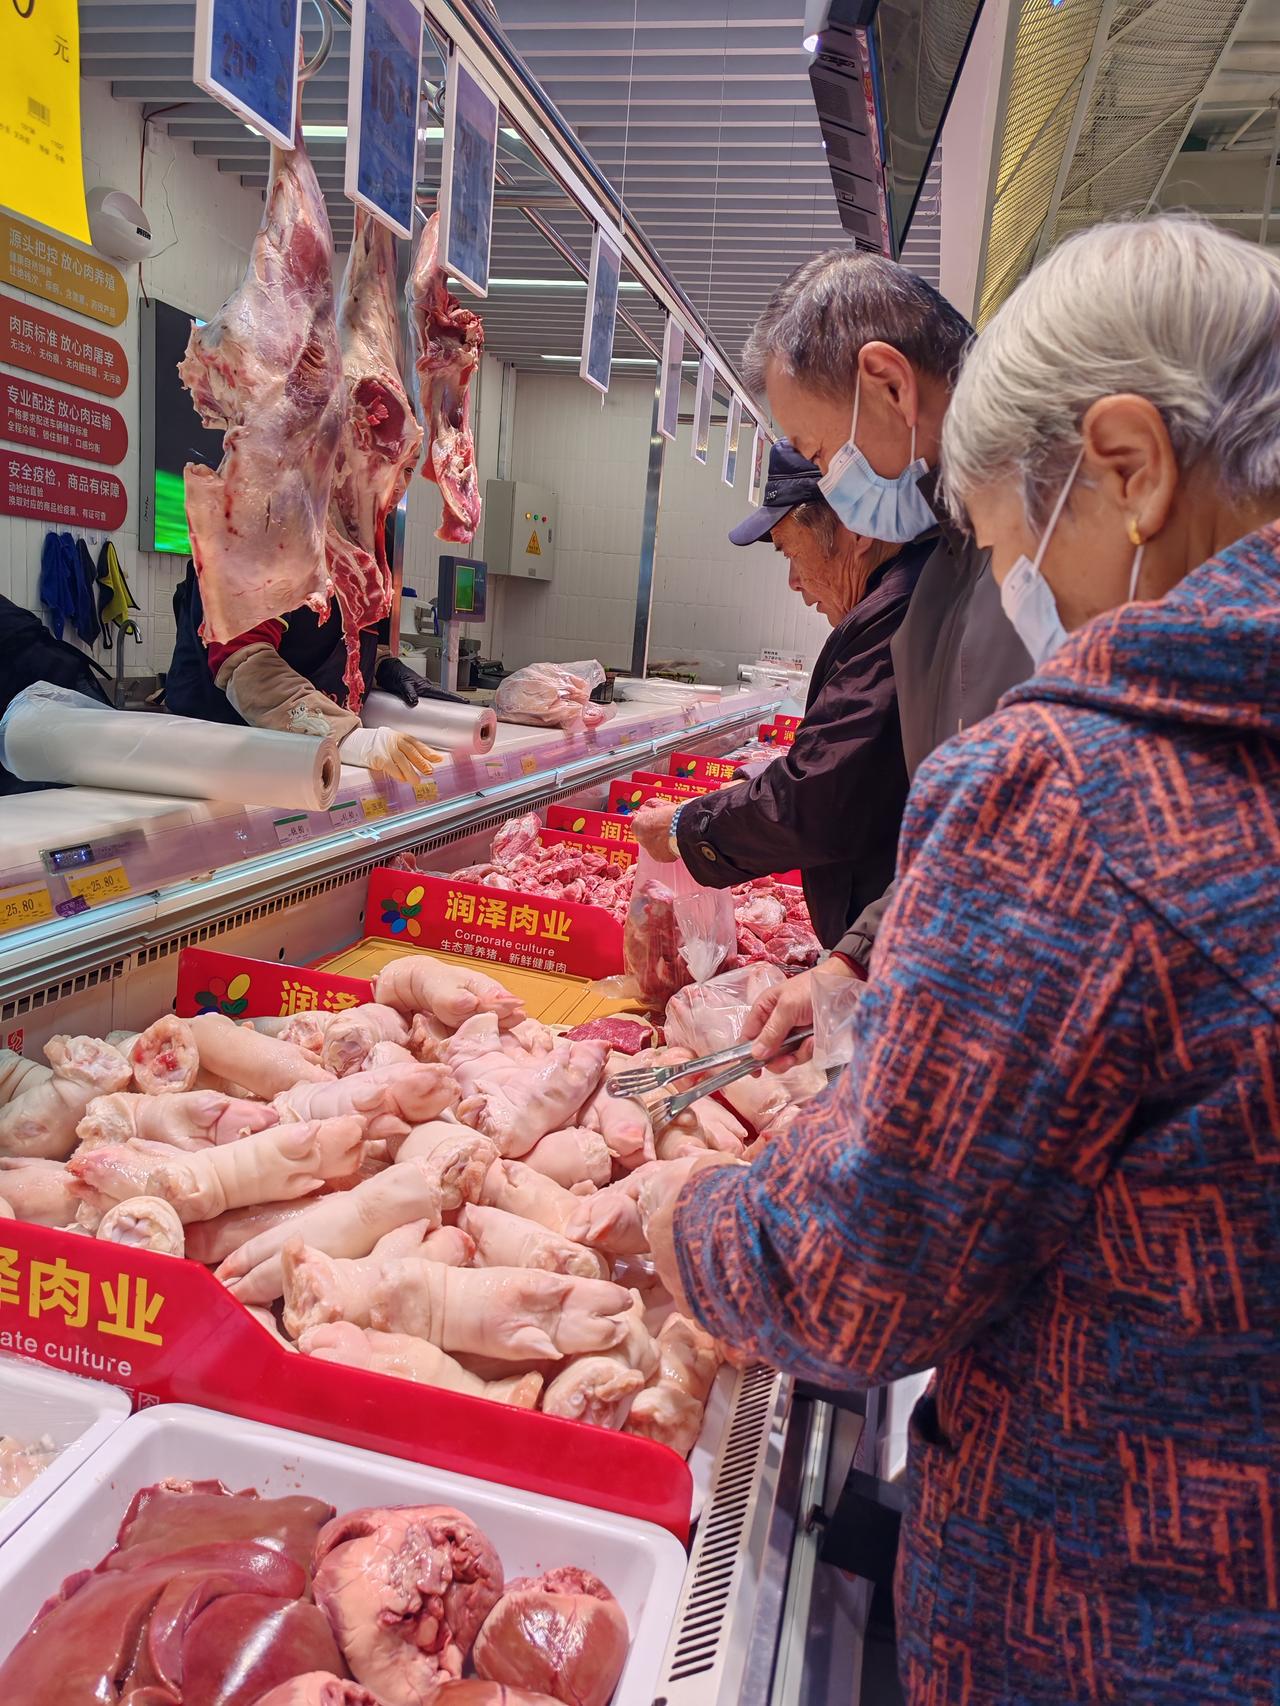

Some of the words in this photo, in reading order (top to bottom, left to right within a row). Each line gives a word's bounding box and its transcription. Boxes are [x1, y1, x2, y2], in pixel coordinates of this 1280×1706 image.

[54, 34, 70, 63] 元
[9, 228, 58, 266] 源头把控
[61, 251, 115, 291] 放心肉养殖
[9, 315, 58, 348] 肉质标准
[60, 334, 114, 368] 放心肉屠宰
[7, 384, 56, 415] 专业配送
[57, 399, 112, 431] 放心肉运输
[90, 875, 114, 892] 25.80
[5, 898, 34, 917] 25.80
[444, 890, 573, 942] 润泽肉业
[454, 929, 513, 949] Corporate
[514, 941, 555, 957] culture
[44, 1342, 132, 1377] culture
